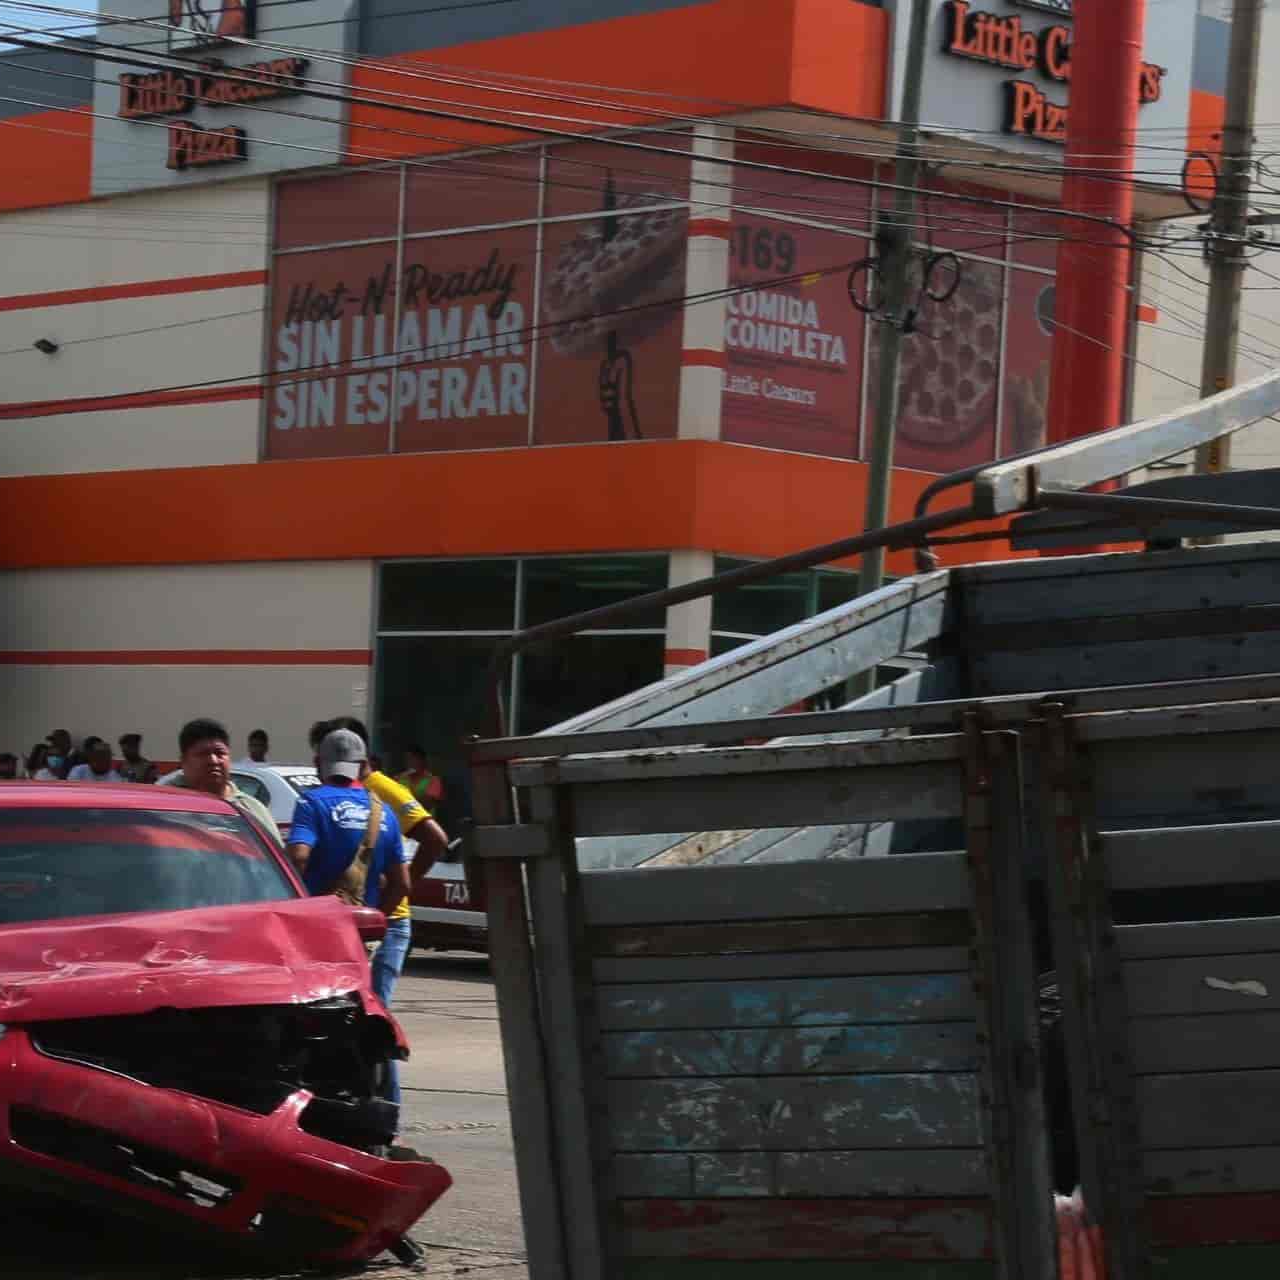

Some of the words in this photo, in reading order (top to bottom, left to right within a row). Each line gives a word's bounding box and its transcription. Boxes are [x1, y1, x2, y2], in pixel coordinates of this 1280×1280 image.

[948, 1, 1038, 71] Little
[118, 70, 189, 119] Little
[1011, 80, 1071, 141] Piz
[166, 121, 243, 169] Pizza
[729, 225, 796, 273] 169
[728, 286, 820, 329] COMIDA
[277, 320, 341, 372] SIN
[351, 302, 525, 369] LLAMAR
[724, 319, 848, 367] COMPLETA
[274, 378, 337, 430] SIN
[346, 362, 527, 425] ESPERAR
